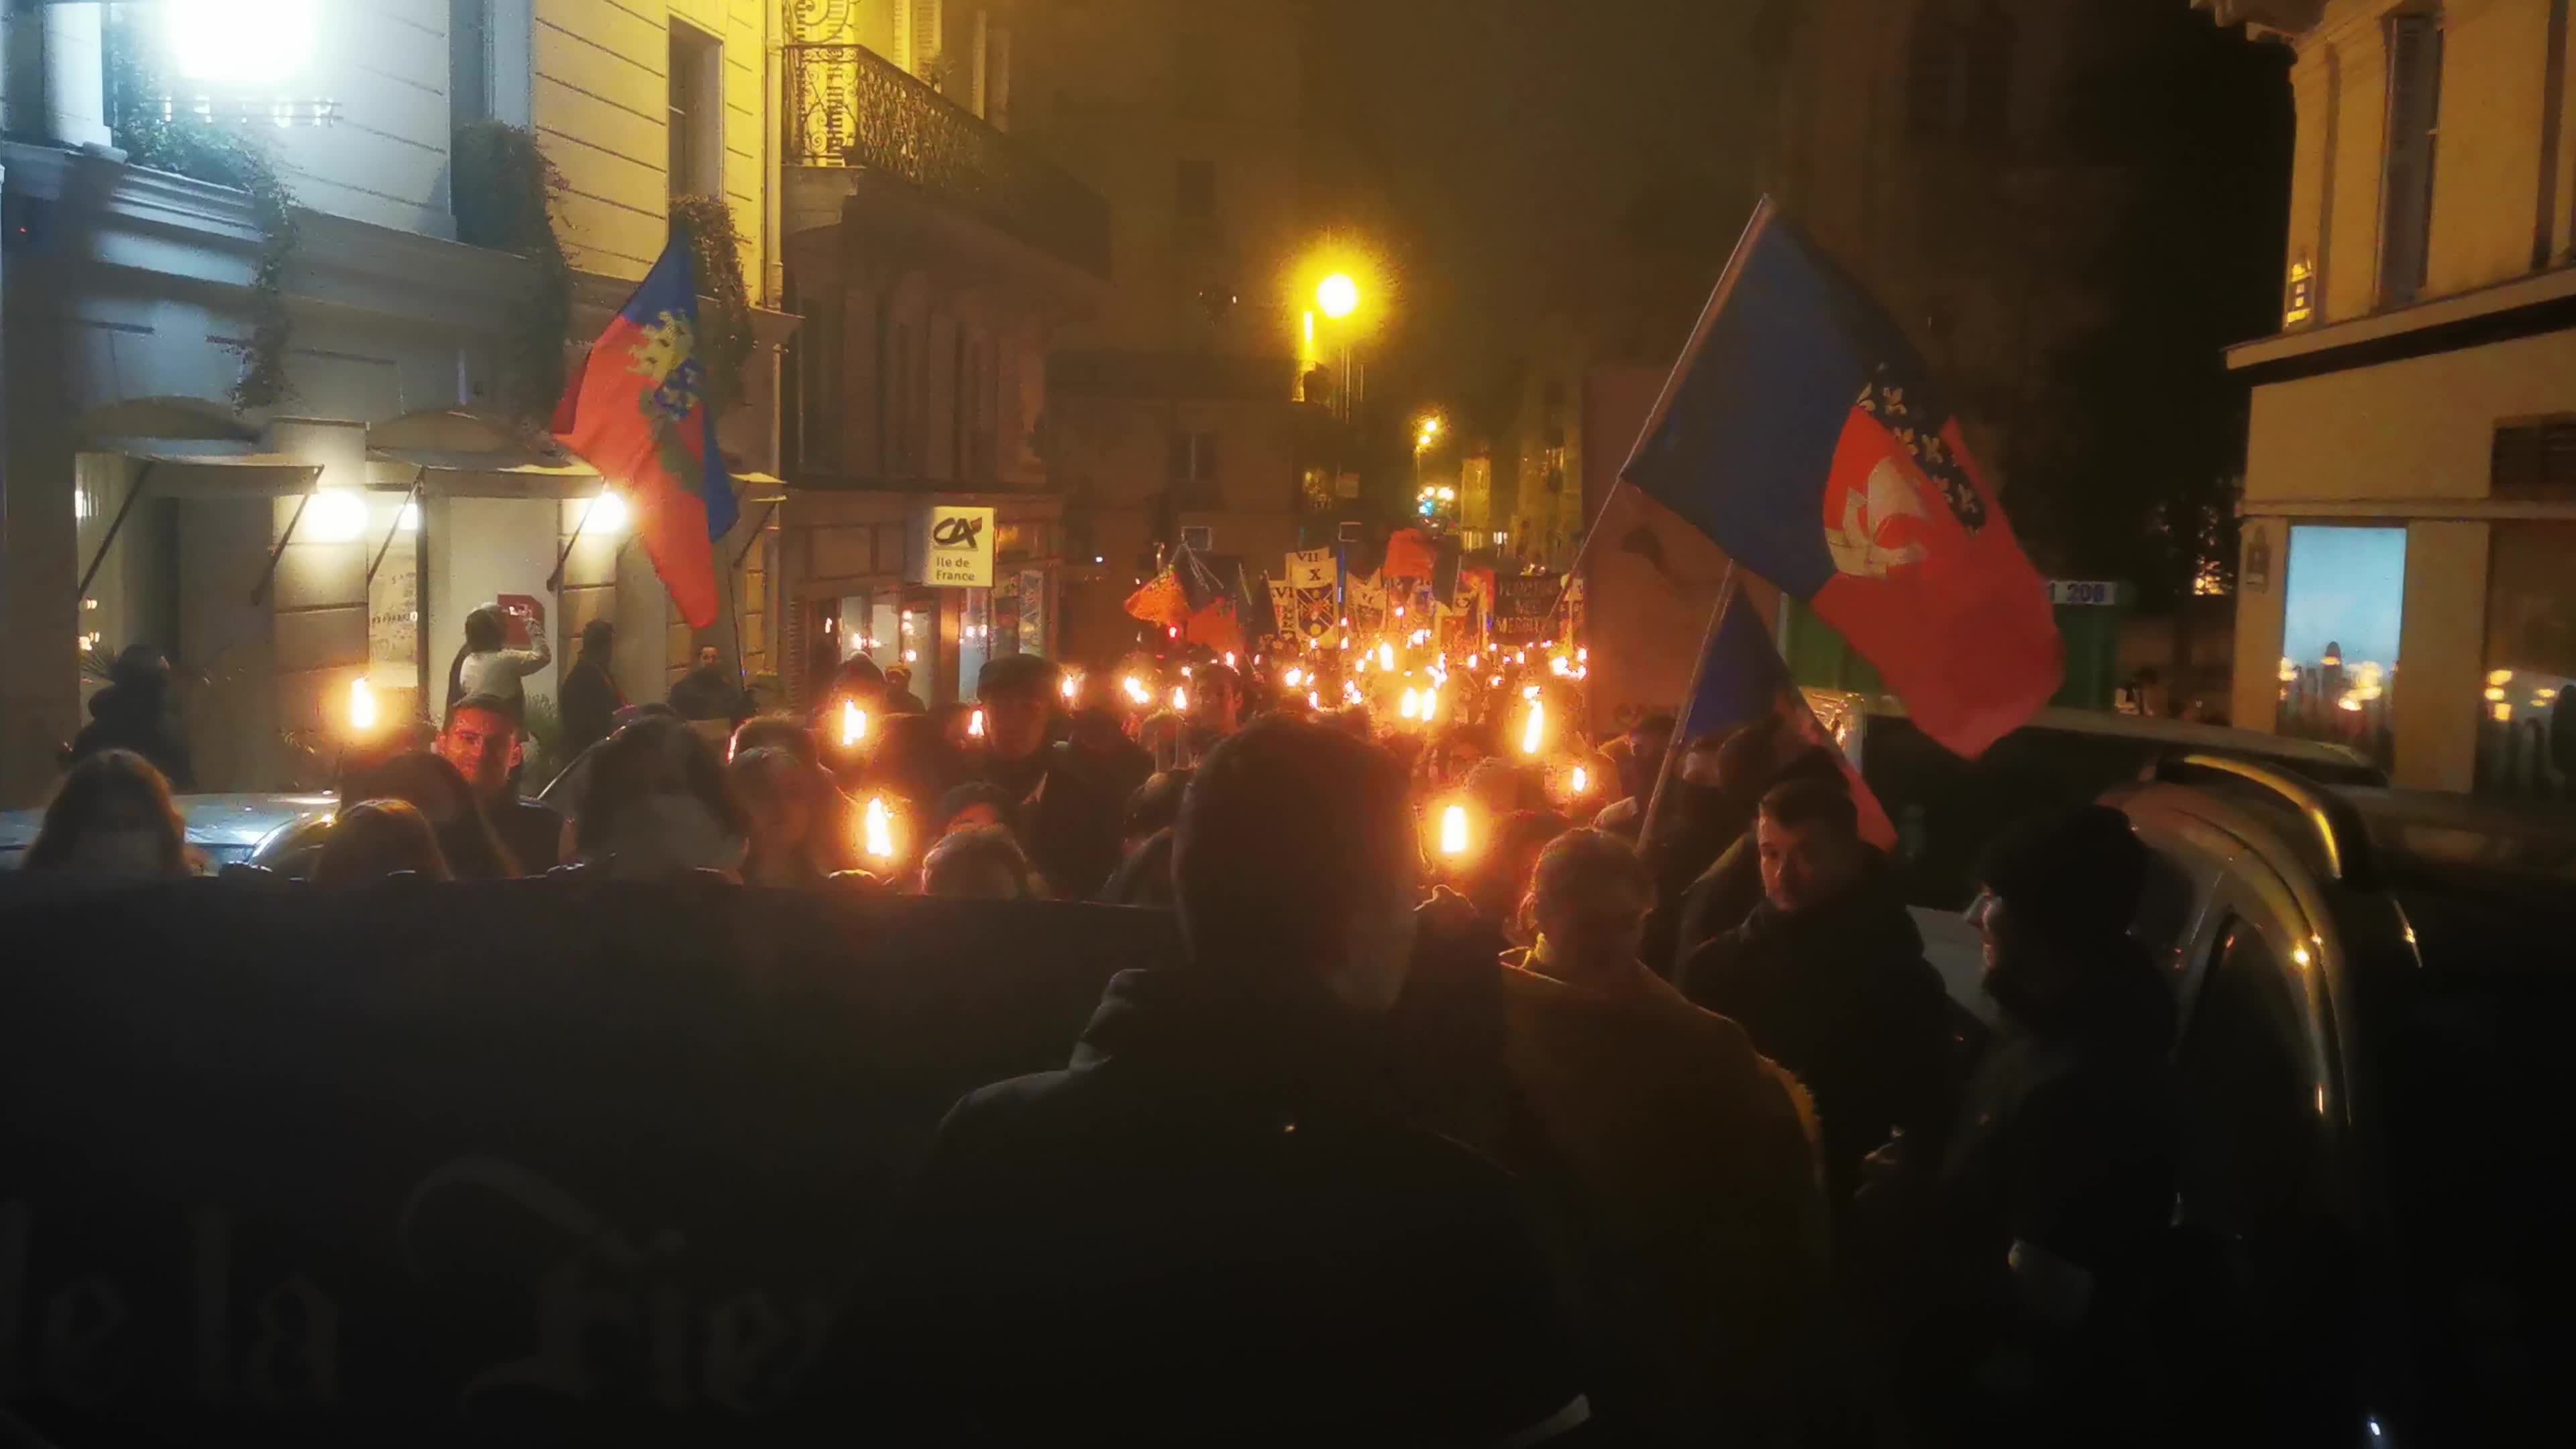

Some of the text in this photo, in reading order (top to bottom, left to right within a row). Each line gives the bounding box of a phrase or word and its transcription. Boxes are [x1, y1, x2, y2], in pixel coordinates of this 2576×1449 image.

[955, 557, 970, 568] de
[936, 570, 975, 580] France
[1309, 569, 1321, 580] X
[186, 1204, 344, 1410] la
